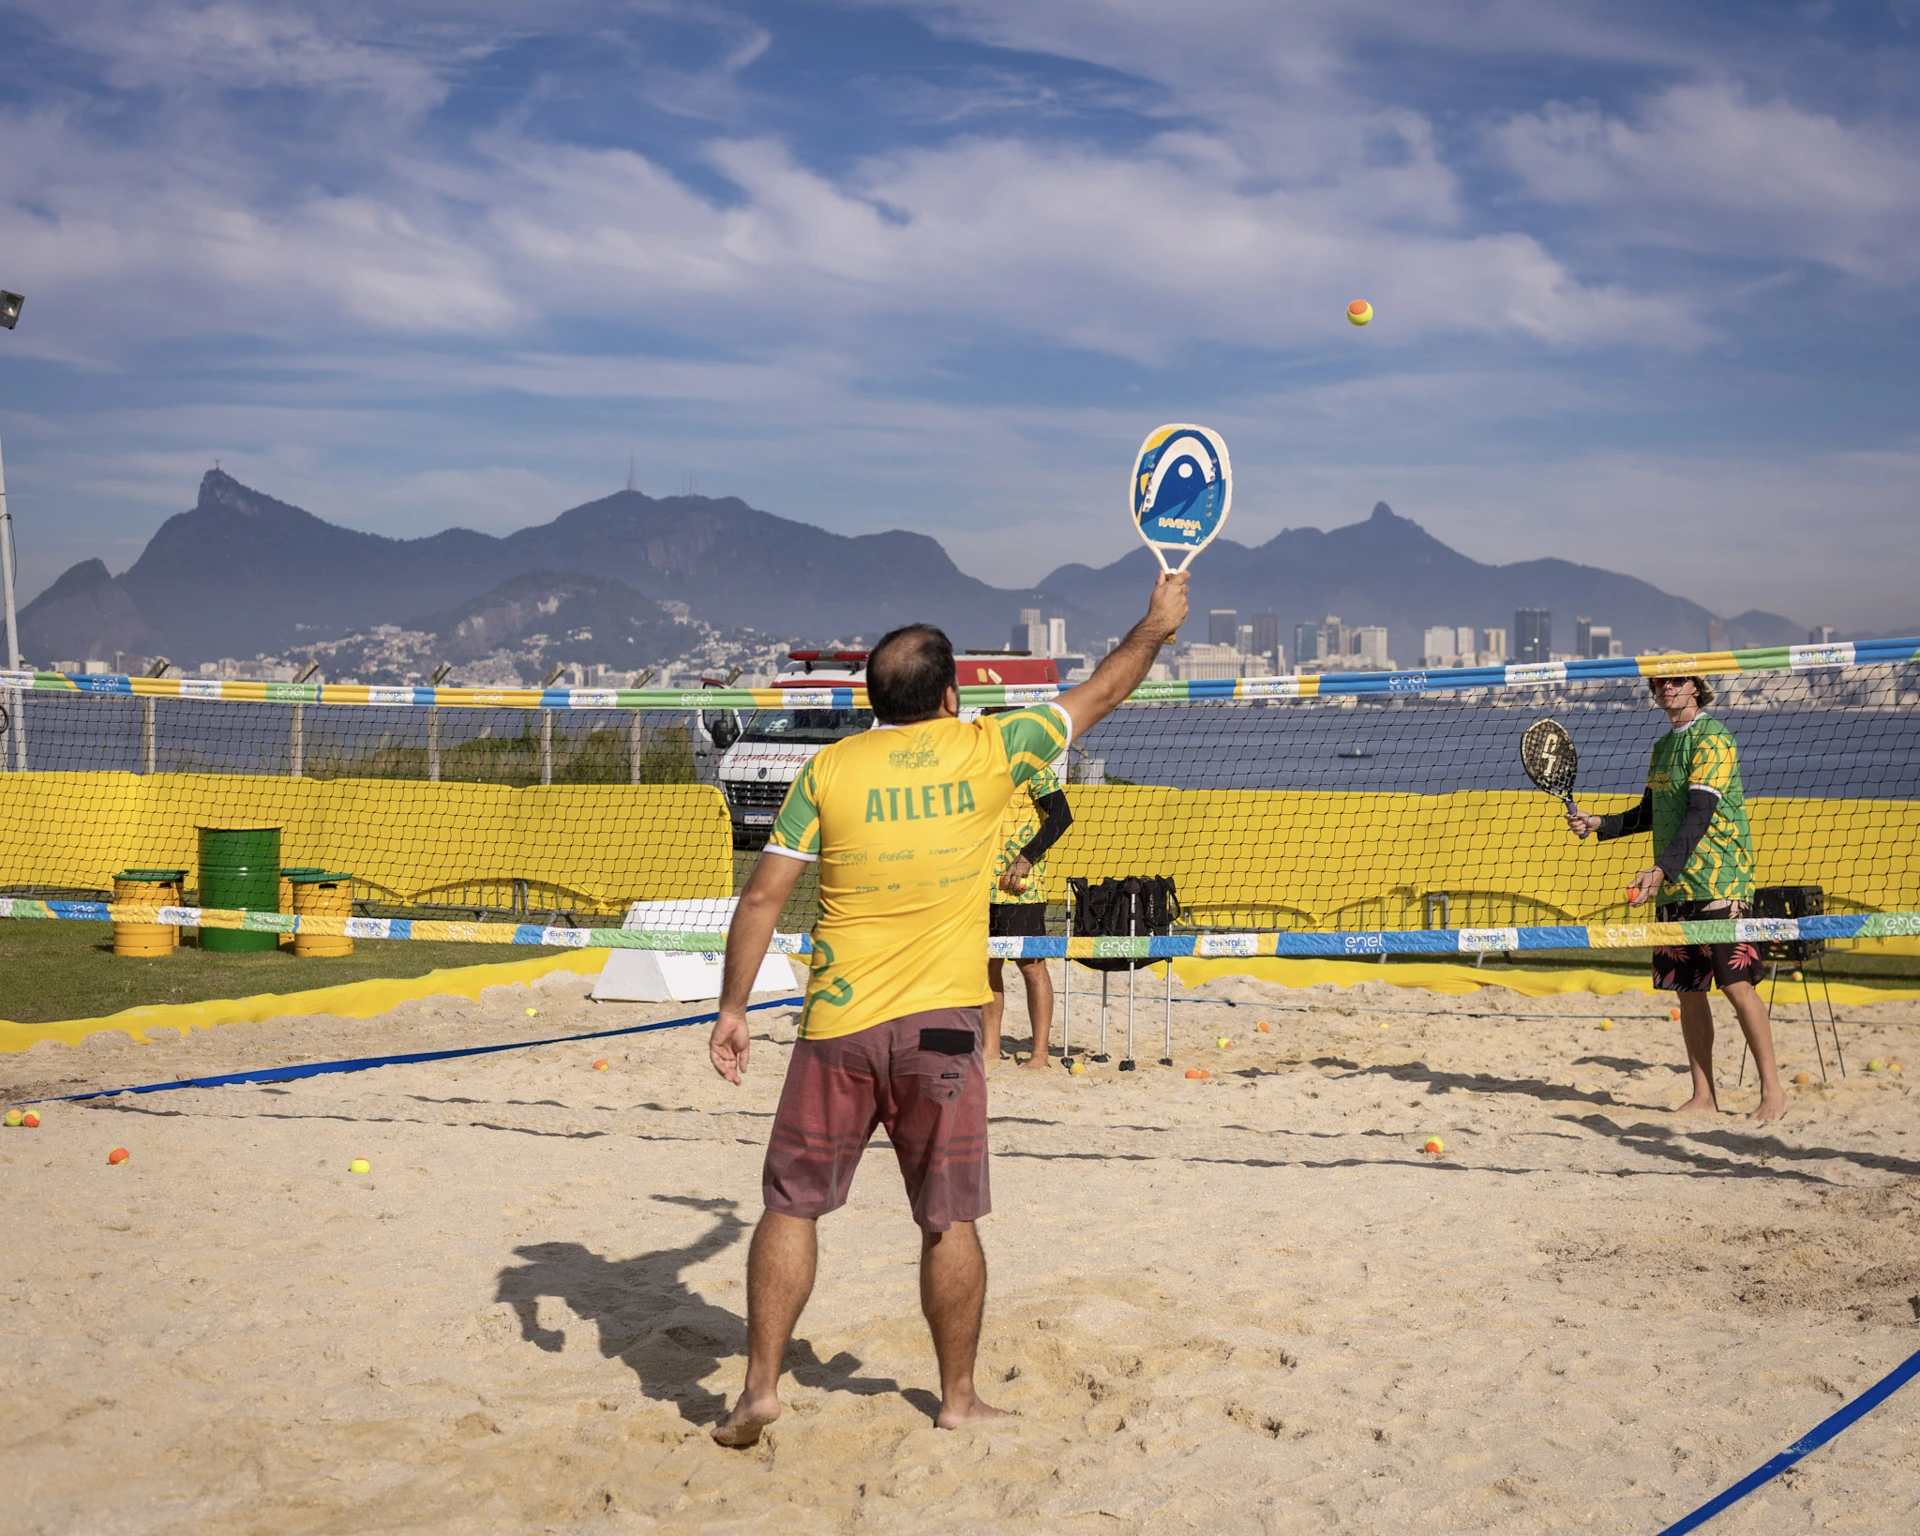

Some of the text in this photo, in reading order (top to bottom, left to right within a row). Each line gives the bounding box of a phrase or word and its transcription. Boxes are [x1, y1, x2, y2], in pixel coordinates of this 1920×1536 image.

[1158, 517, 1202, 531] RAVENNA
[1799, 647, 1842, 659] energia
[1657, 656, 1697, 669] enel
[1389, 672, 1427, 684] enel
[1514, 667, 1555, 678] energia
[92, 678, 119, 687] enel
[277, 686, 304, 696] enel
[1138, 683, 1173, 694] enel
[473, 691, 503, 701] enel
[681, 691, 713, 702] enel
[865, 780, 976, 823] ATLETA
[841, 851, 868, 862] enel
[254, 914, 283, 923] enel
[1884, 917, 1920, 929] ene
[448, 925, 478, 935] enel
[1606, 926, 1646, 940] enel
[1745, 922, 1786, 933] energia
[652, 933, 685, 944] enel
[1209, 938, 1247, 948] energia
[1344, 934, 1382, 947] enel
[1467, 932, 1506, 944] energia
[988, 941, 1014, 952] ergia
[1100, 939, 1135, 952] enel
